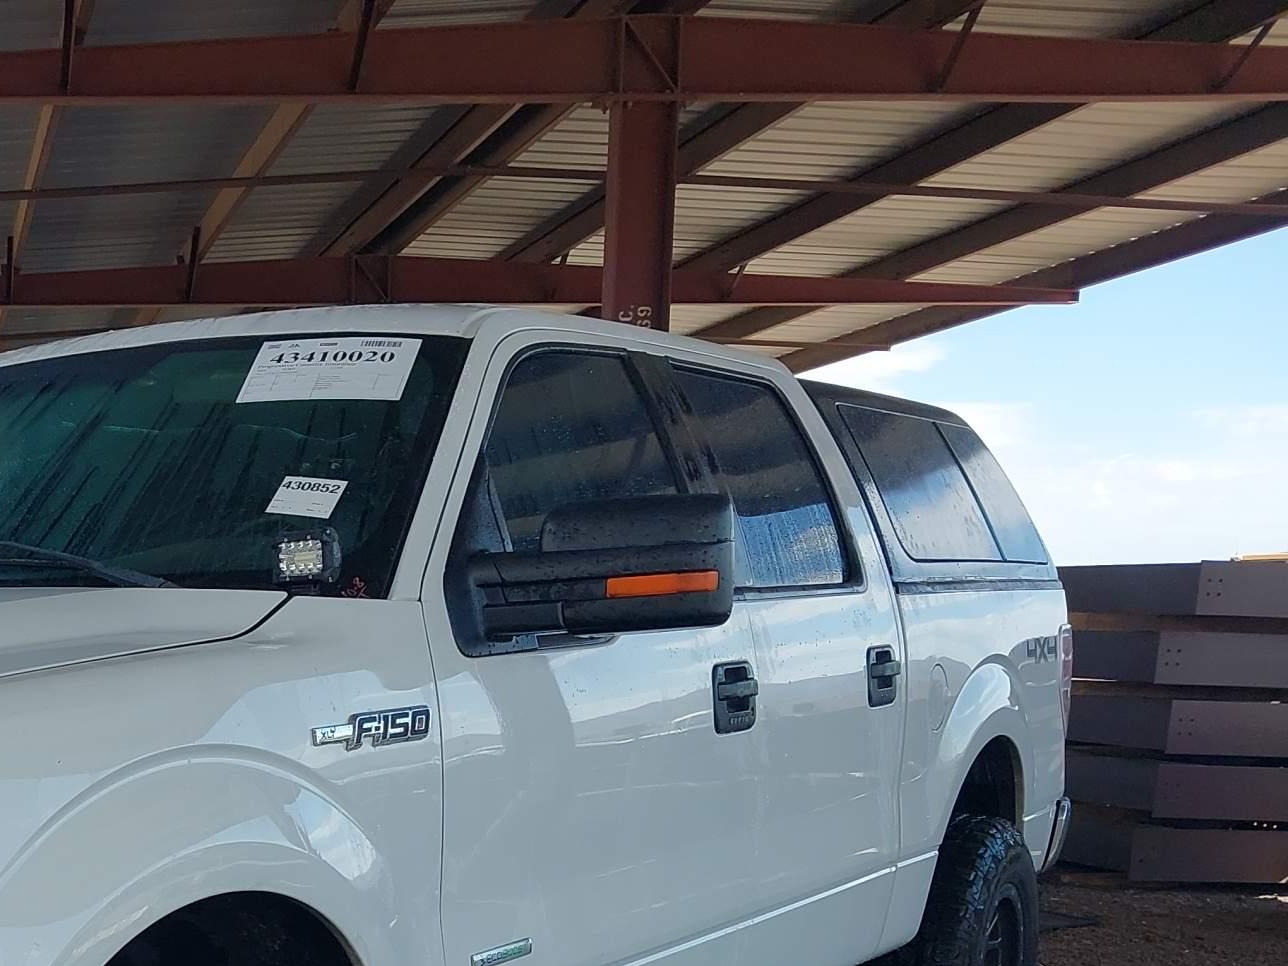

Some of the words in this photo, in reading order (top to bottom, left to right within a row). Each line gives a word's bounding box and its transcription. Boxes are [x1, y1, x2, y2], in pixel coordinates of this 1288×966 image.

[269, 350, 396, 364] 43410020
[282, 480, 342, 494] 430852
[1026, 636, 1058, 664] 4X4
